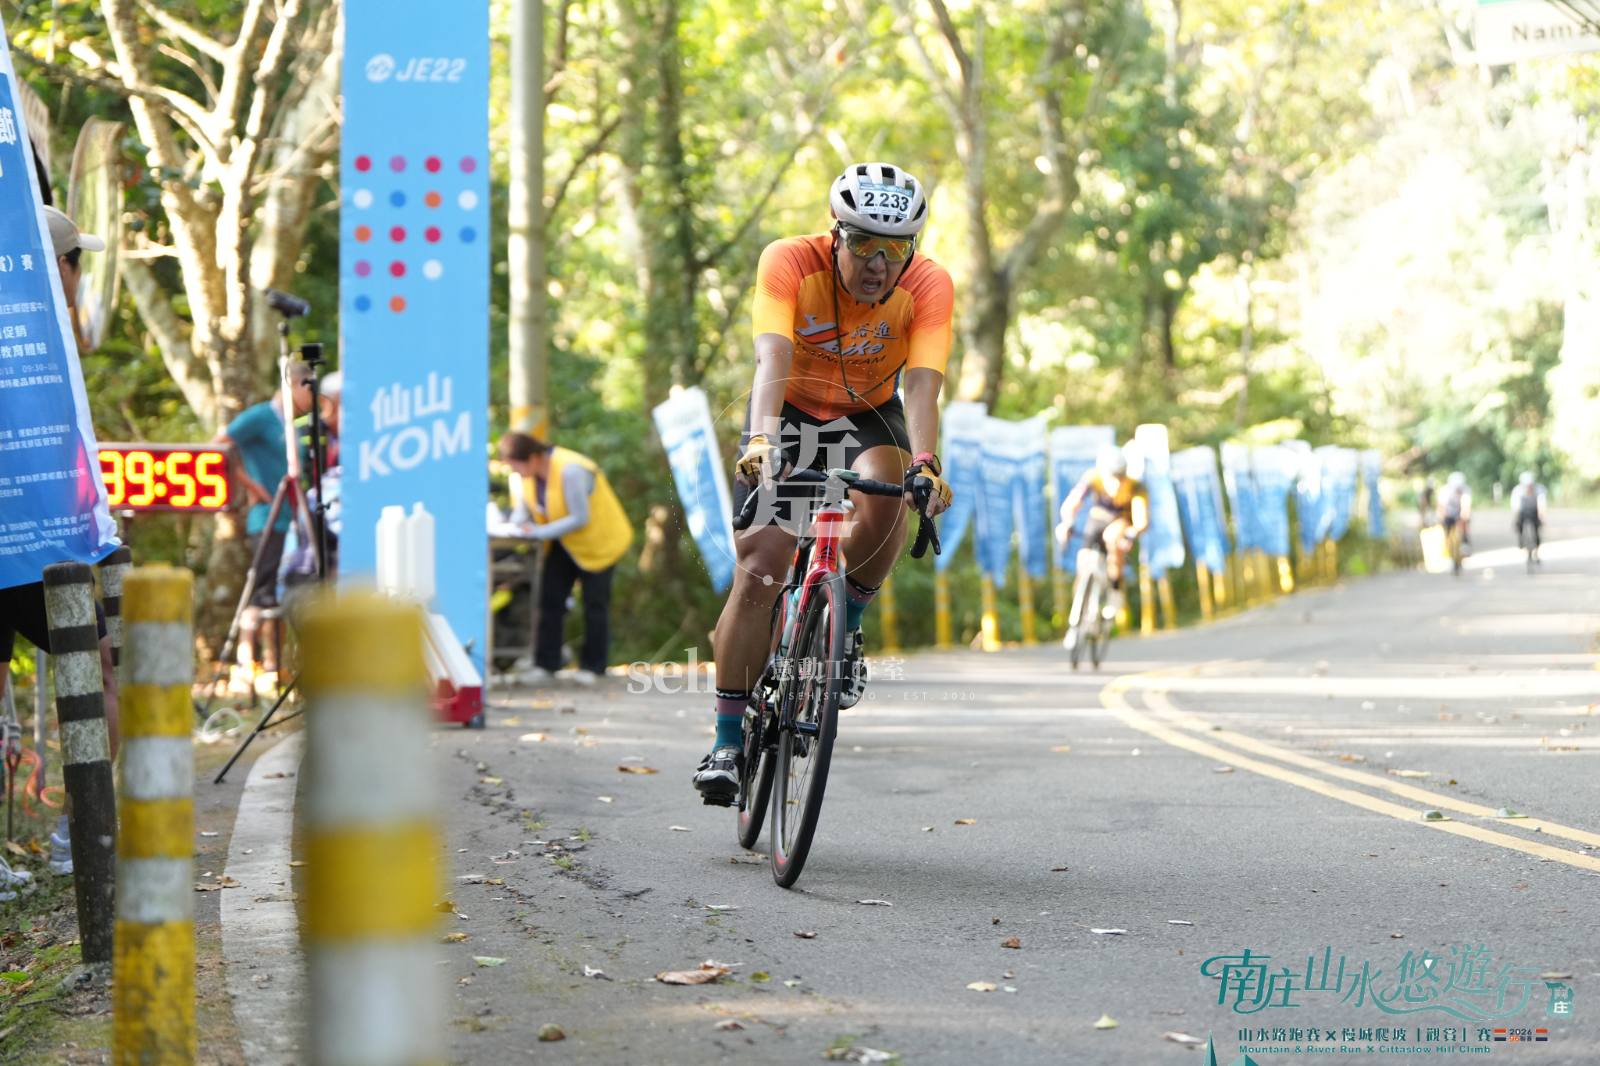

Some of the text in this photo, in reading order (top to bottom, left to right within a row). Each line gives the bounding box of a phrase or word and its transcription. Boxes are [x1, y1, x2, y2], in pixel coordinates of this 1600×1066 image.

[395, 57, 467, 83] JE22
[0, 325, 28, 340] 促銷
[369, 371, 453, 433] 仙山
[358, 410, 472, 482] KOM
